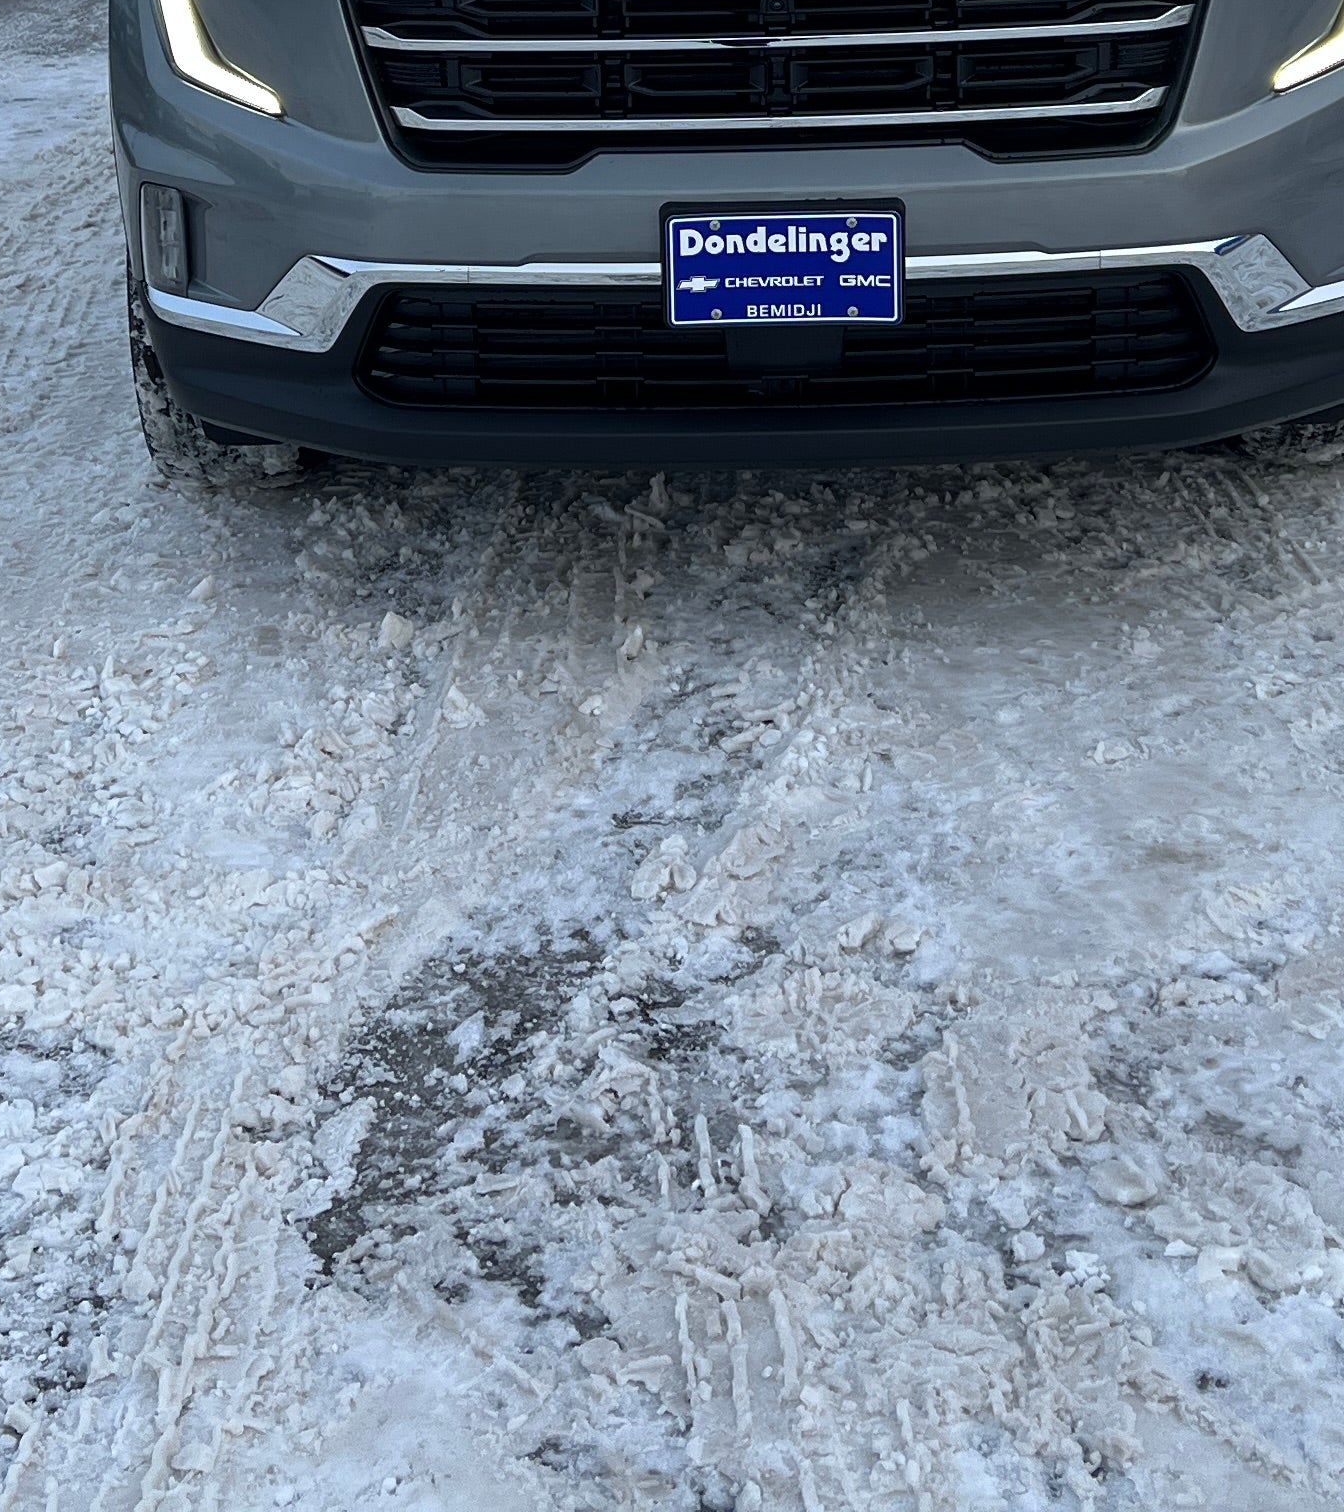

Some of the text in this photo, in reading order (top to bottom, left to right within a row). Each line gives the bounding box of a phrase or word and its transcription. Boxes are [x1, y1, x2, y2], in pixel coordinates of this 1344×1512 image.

[679, 226, 888, 262] Dondelinger
[724, 274, 891, 288] CHEVROLET GMC
[747, 304, 822, 318] BEMIDJI
